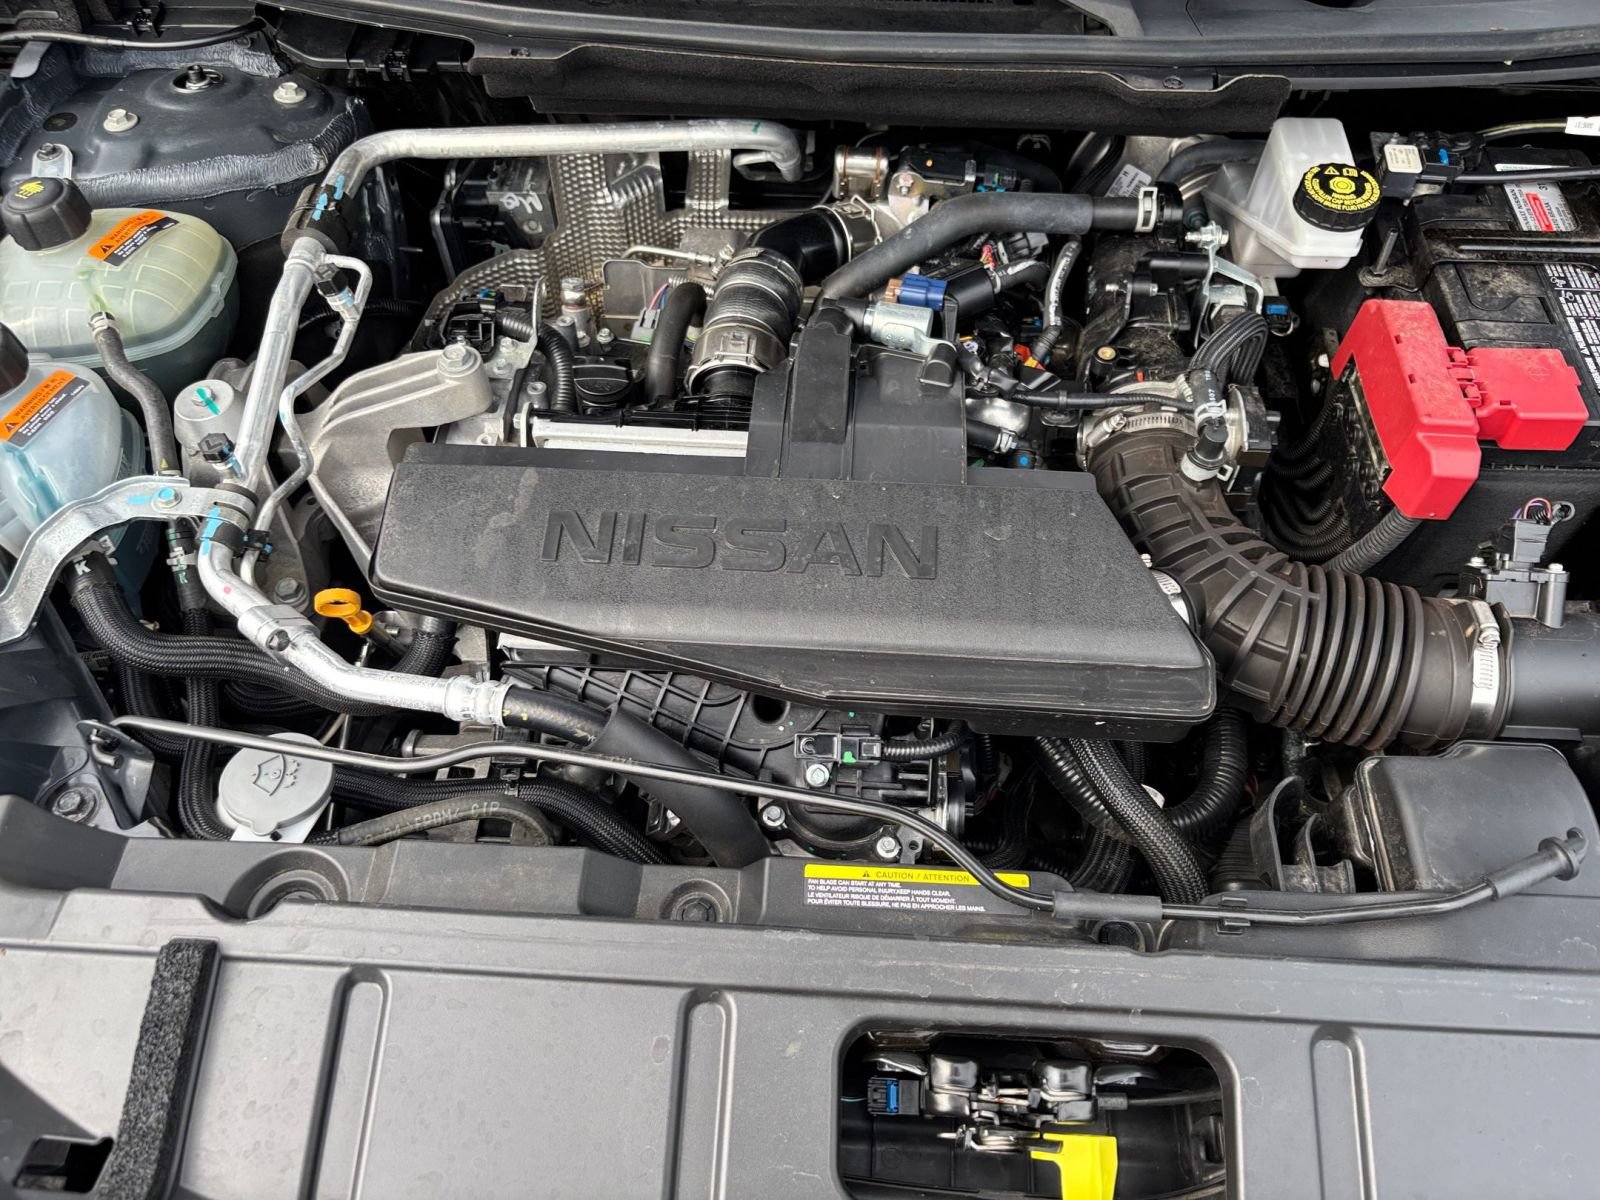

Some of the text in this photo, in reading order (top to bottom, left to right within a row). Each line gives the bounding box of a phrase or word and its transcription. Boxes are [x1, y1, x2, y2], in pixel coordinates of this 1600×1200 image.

[15, 390, 42, 417] WARNING
[540, 509, 939, 580] NISSAN
[74, 560, 92, 576] K
[876, 871, 914, 880] CAUTION
[922, 873, 970, 882] ATTENTION
[848, 886, 877, 894] PERSONAL
[824, 898, 842, 906] ÉVITER
[880, 894, 910, 902] DÉMARRER
